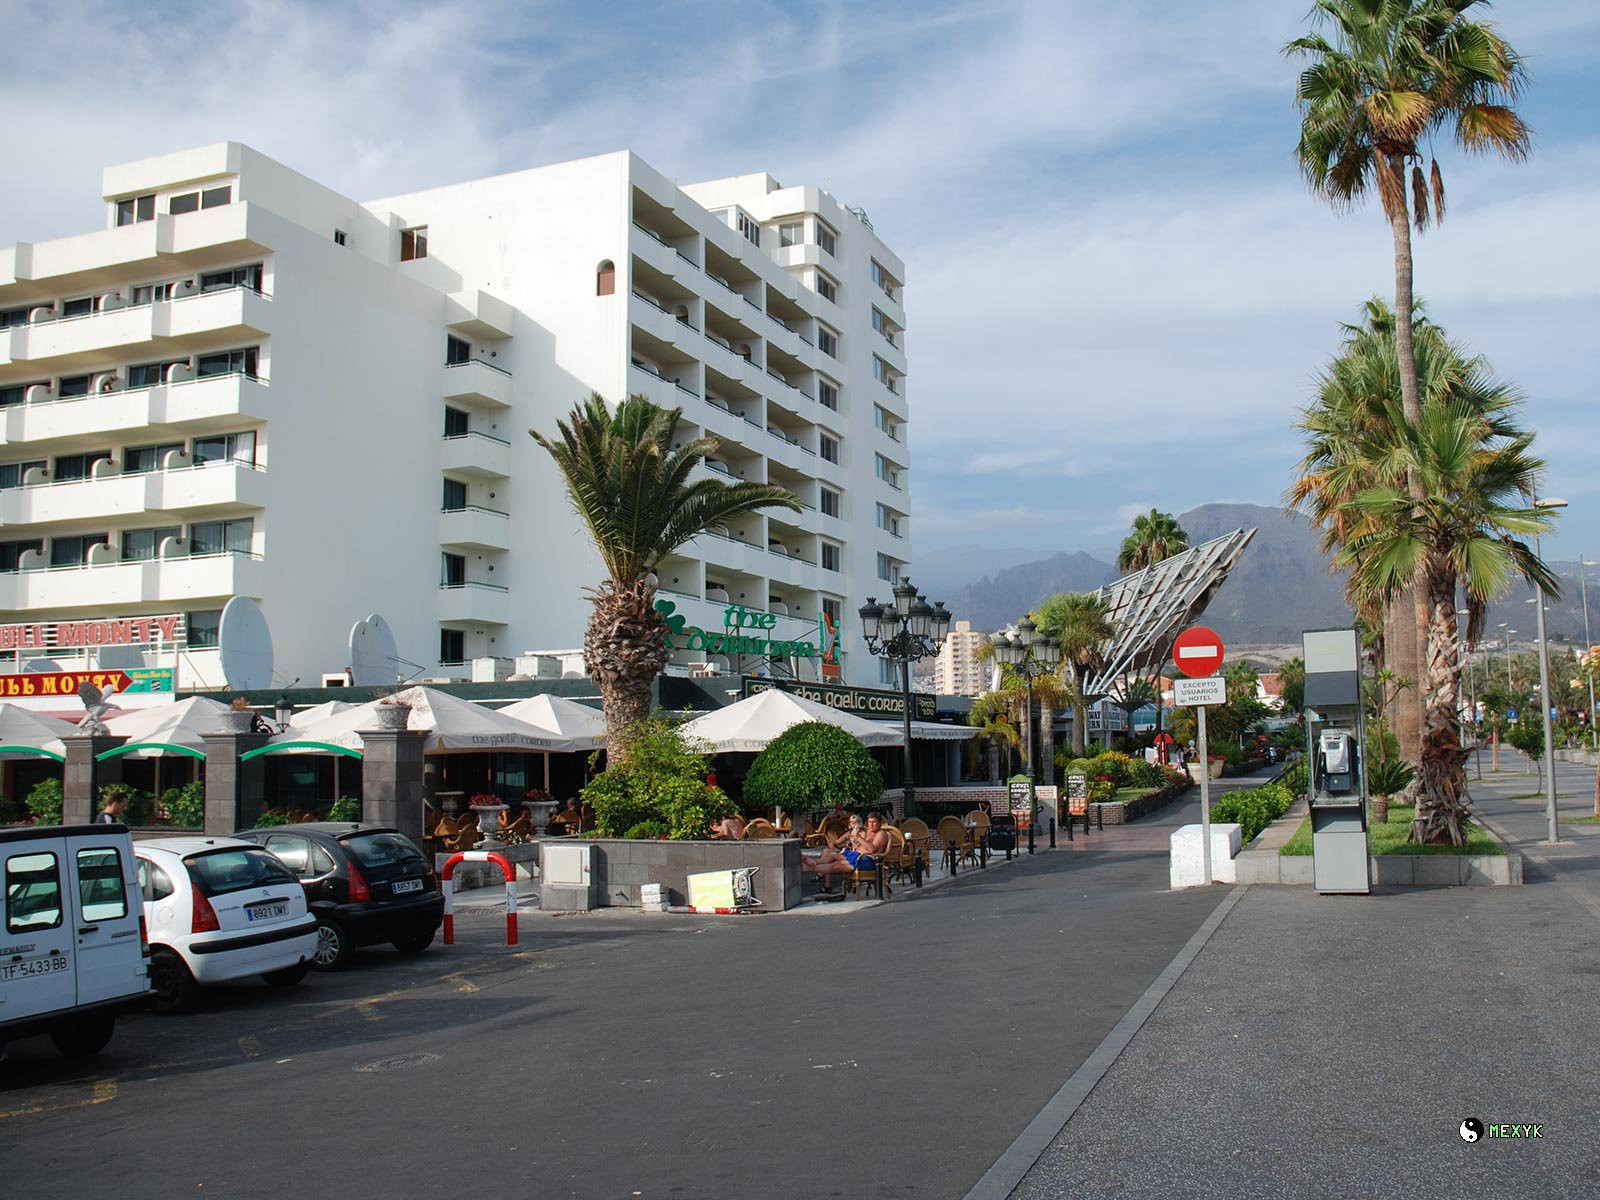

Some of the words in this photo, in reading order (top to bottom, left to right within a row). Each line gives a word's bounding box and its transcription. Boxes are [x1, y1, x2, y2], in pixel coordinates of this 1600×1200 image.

[723, 604, 777, 630] the
[56, 616, 178, 647] MONTY
[825, 691, 866, 709] gaelic
[868, 696, 905, 712] corne
